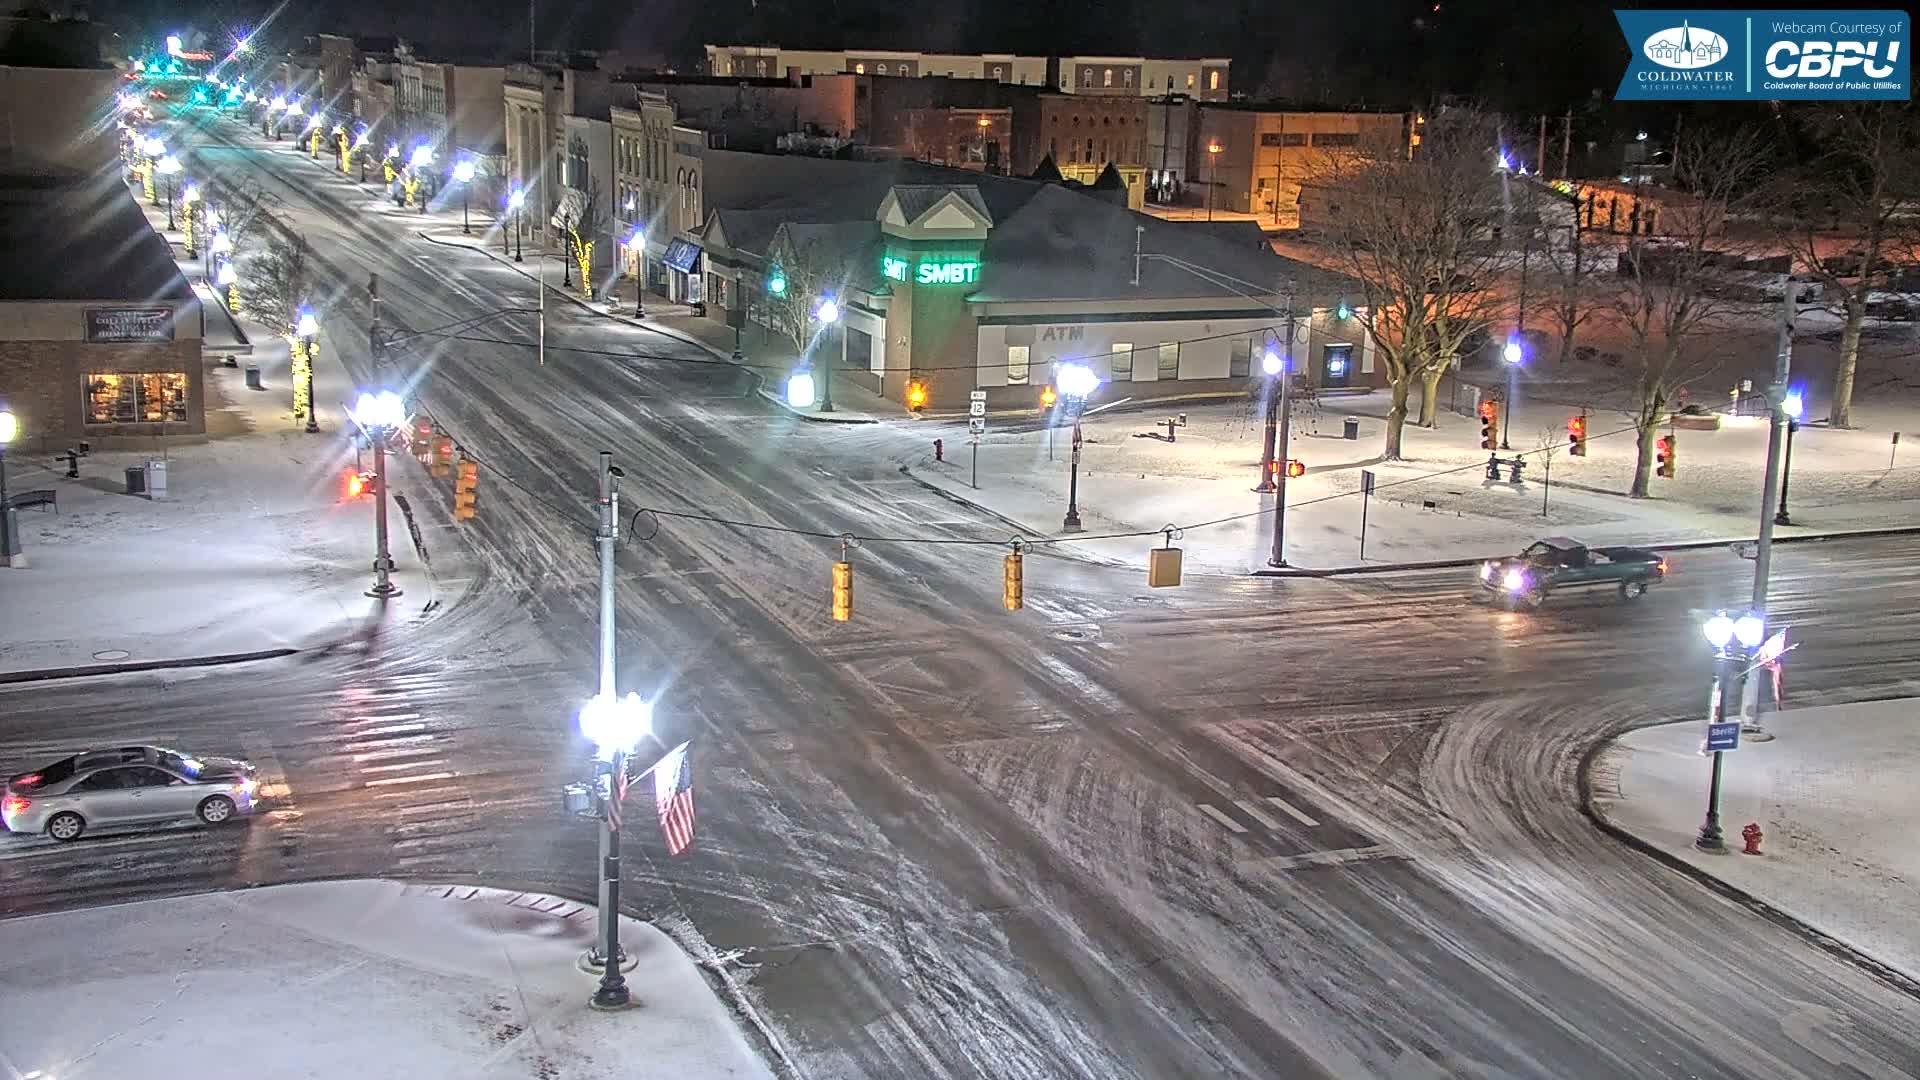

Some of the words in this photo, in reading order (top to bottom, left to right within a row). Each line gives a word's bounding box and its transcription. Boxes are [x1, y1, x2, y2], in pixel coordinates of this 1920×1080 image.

[919, 263, 978, 283] SMBT
[1042, 325, 1085, 341] ATM
[973, 403, 983, 413] 12
